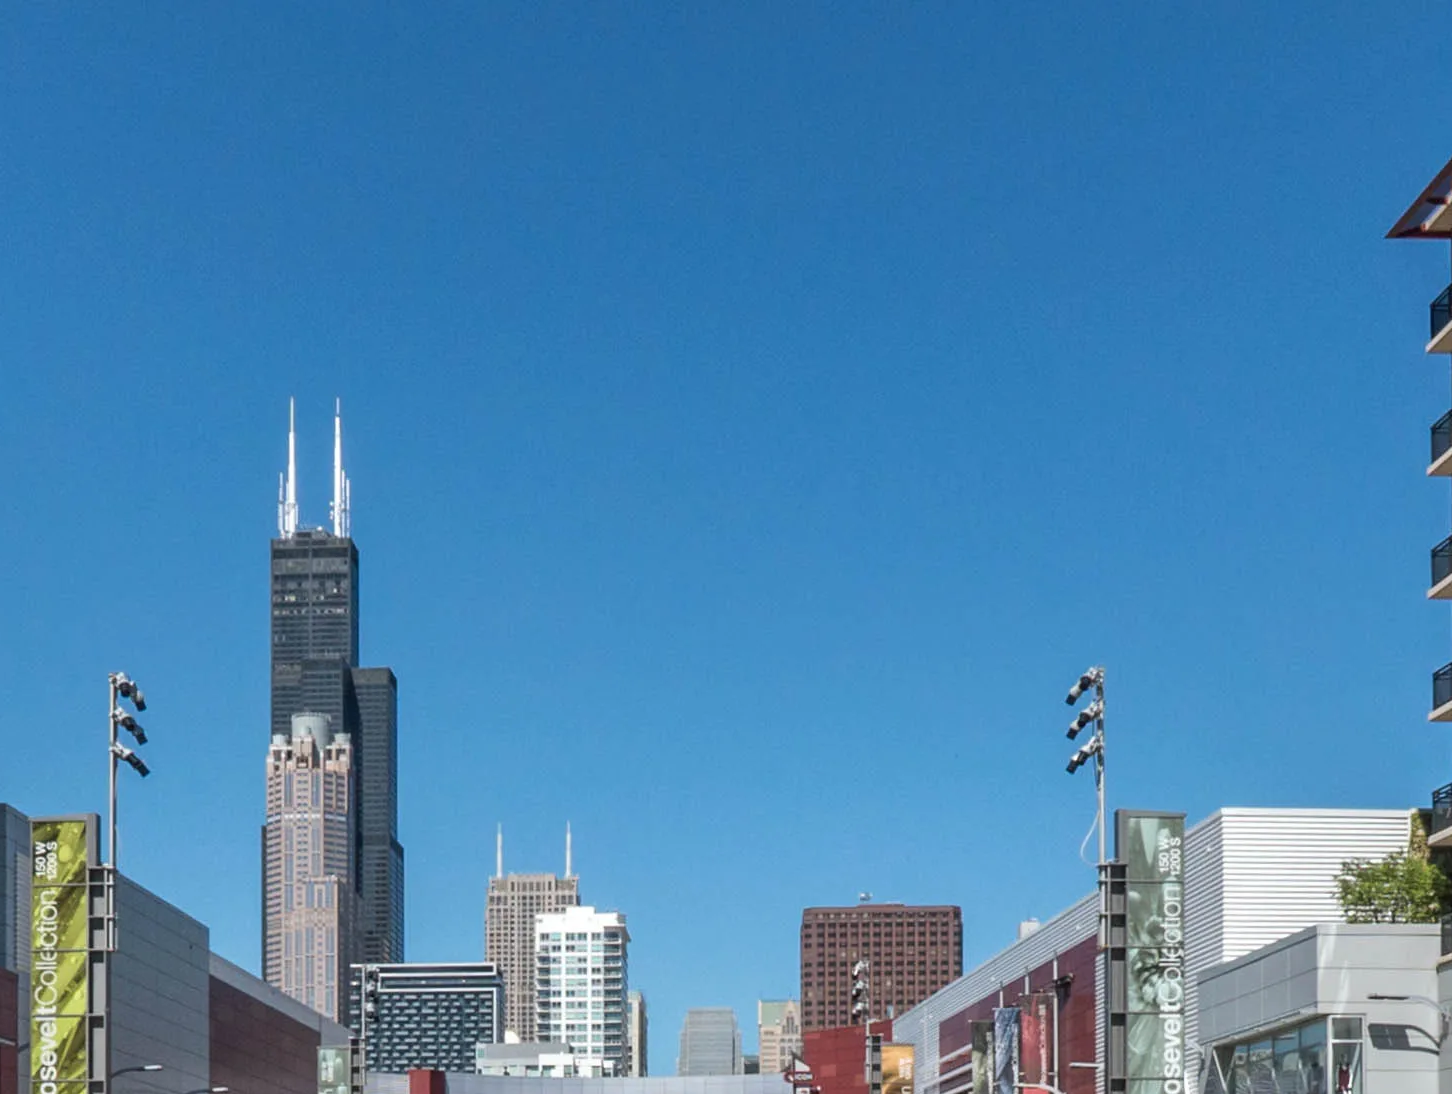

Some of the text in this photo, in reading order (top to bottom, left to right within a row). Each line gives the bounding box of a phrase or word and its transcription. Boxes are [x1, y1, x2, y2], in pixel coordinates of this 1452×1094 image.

[35, 841, 46, 877] 150 W
[47, 841, 57, 880] 1200 S
[1159, 853, 1168, 875] 150
[1170, 837, 1181, 876] 1200 S
